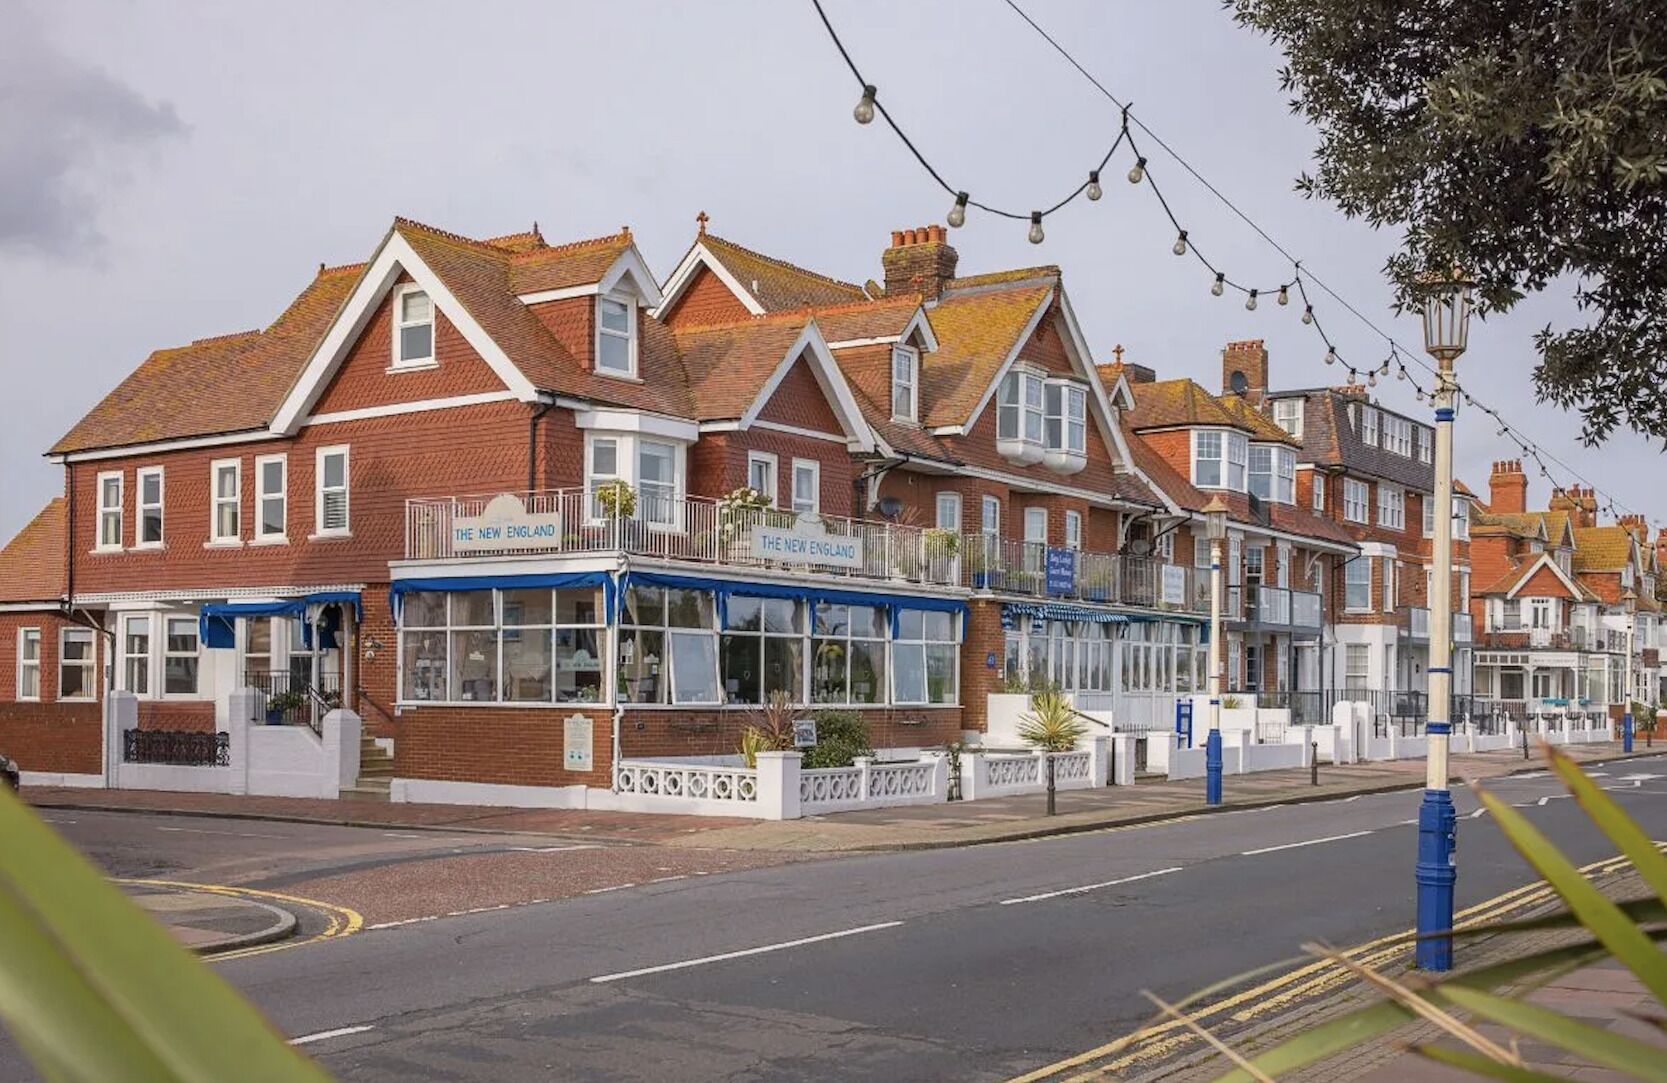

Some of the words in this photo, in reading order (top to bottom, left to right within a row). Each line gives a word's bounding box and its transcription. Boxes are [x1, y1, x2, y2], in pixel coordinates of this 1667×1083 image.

[455, 528, 473, 541] THE
[479, 526, 502, 540] NEW
[507, 524, 555, 538] ENGLAND
[762, 535, 782, 551] THE
[784, 538, 807, 553] NEW
[810, 540, 855, 559] ENGLAND
